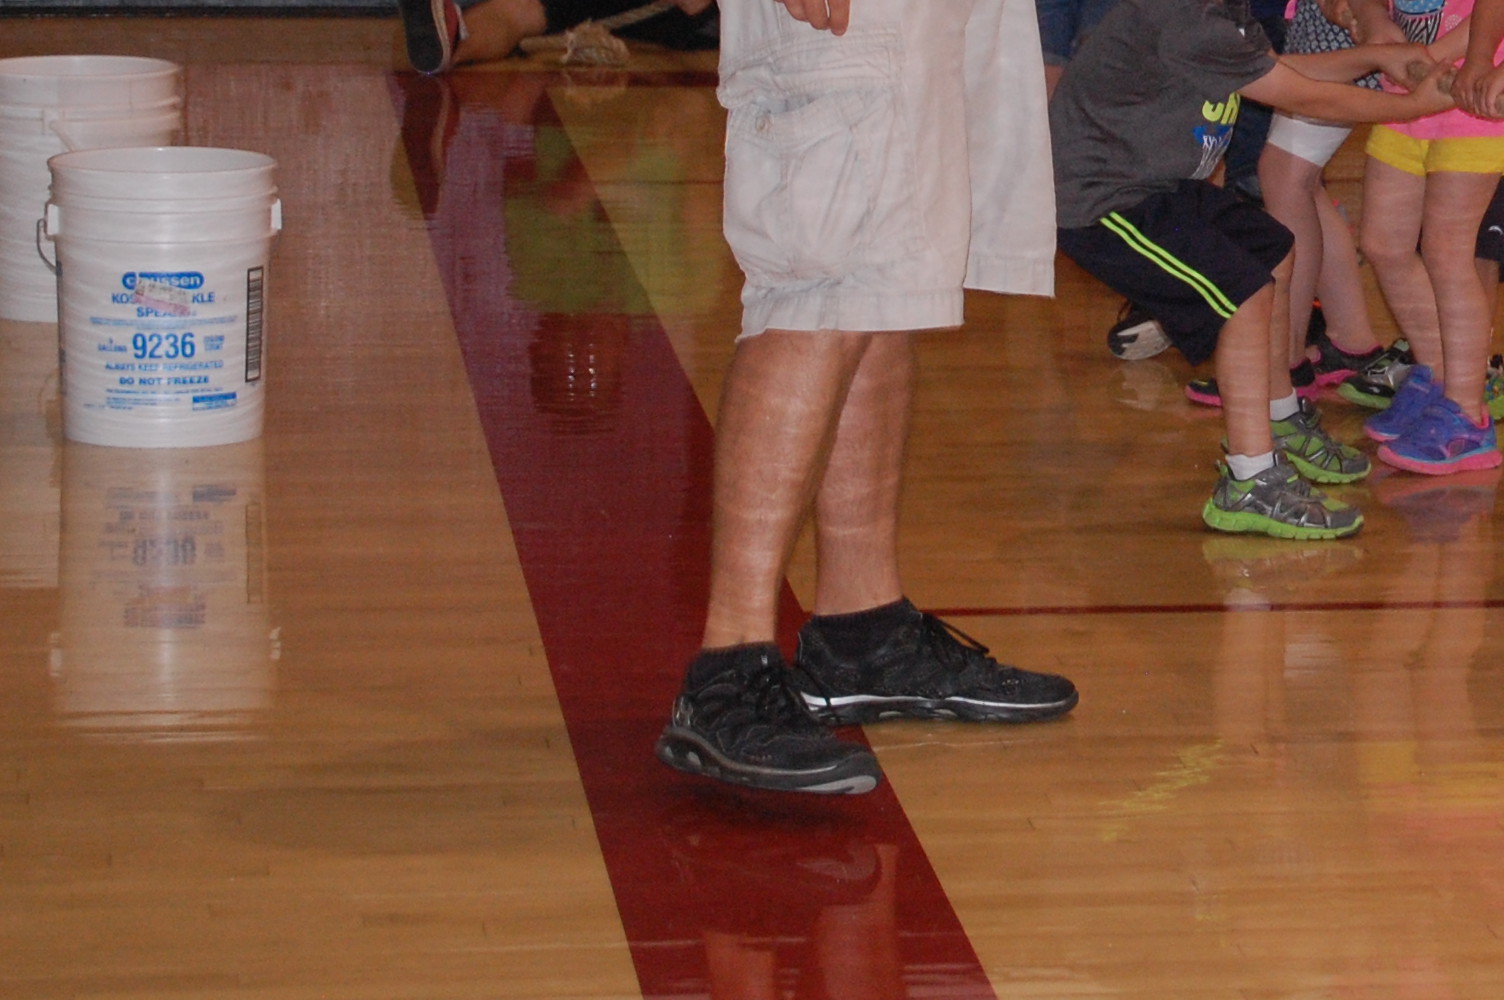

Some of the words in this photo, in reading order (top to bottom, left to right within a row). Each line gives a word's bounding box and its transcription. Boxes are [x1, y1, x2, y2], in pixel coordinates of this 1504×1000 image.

[132, 332, 196, 360] 9236
[119, 376, 135, 386] DO
[138, 376, 162, 386] NOT
[167, 375, 210, 385] FREEZE
